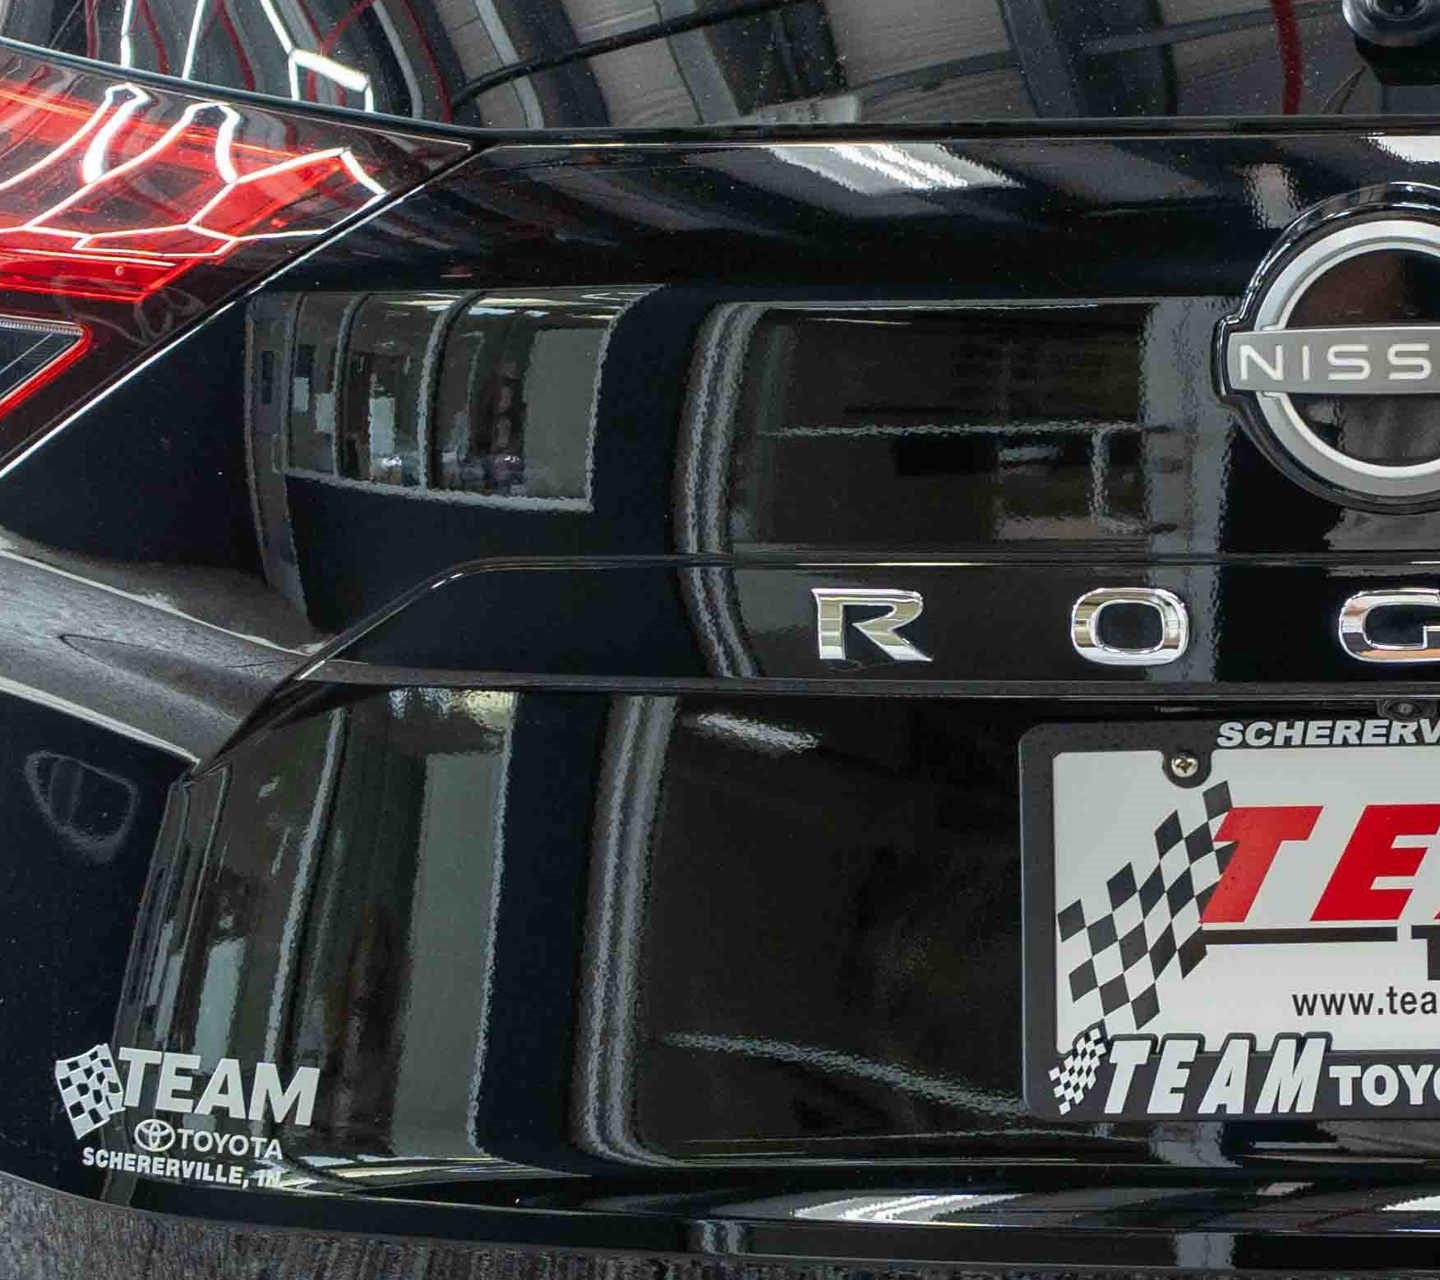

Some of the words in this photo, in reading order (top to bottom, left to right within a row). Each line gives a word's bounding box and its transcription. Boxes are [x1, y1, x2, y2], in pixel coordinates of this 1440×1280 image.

[118, 1047, 321, 1127] TEAM
[177, 1127, 284, 1161] TOYOTA
[81, 1146, 250, 1189] SCHERERVILLE,
